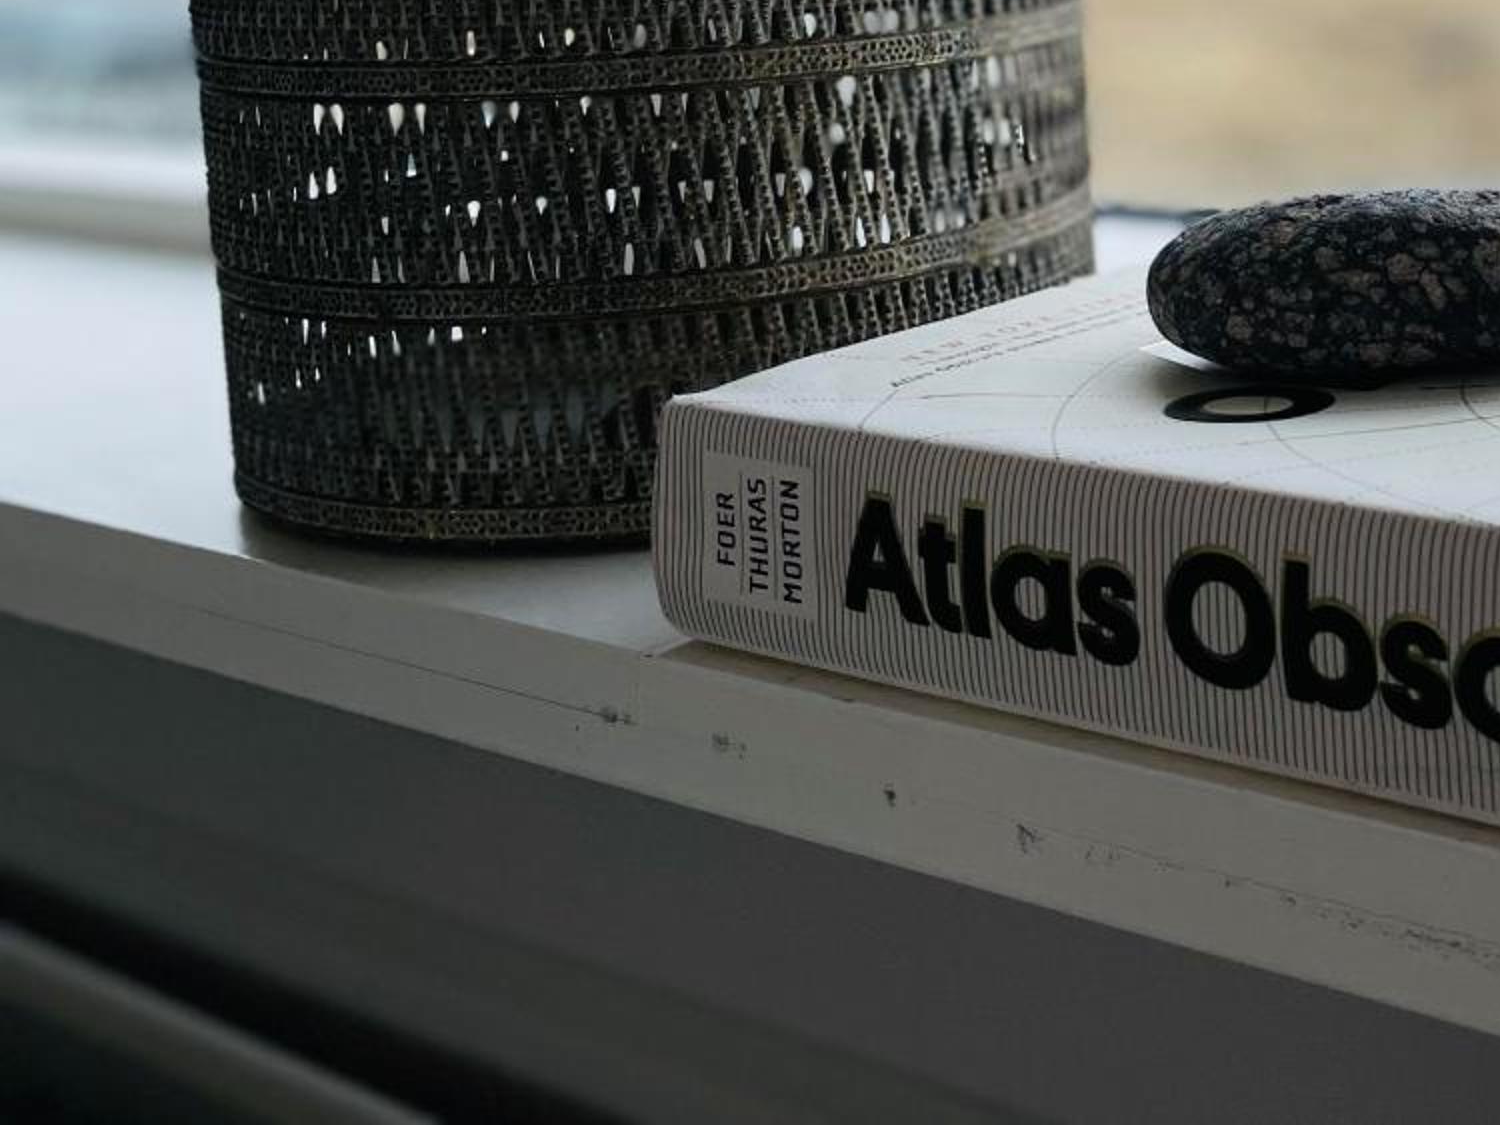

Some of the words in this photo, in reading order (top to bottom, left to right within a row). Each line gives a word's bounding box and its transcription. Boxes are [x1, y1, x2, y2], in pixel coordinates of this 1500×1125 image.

[716, 492, 737, 566] FOER
[748, 478, 769, 594] THURAS
[779, 480, 803, 604] MORTON
[845, 491, 1141, 667] Atlas
